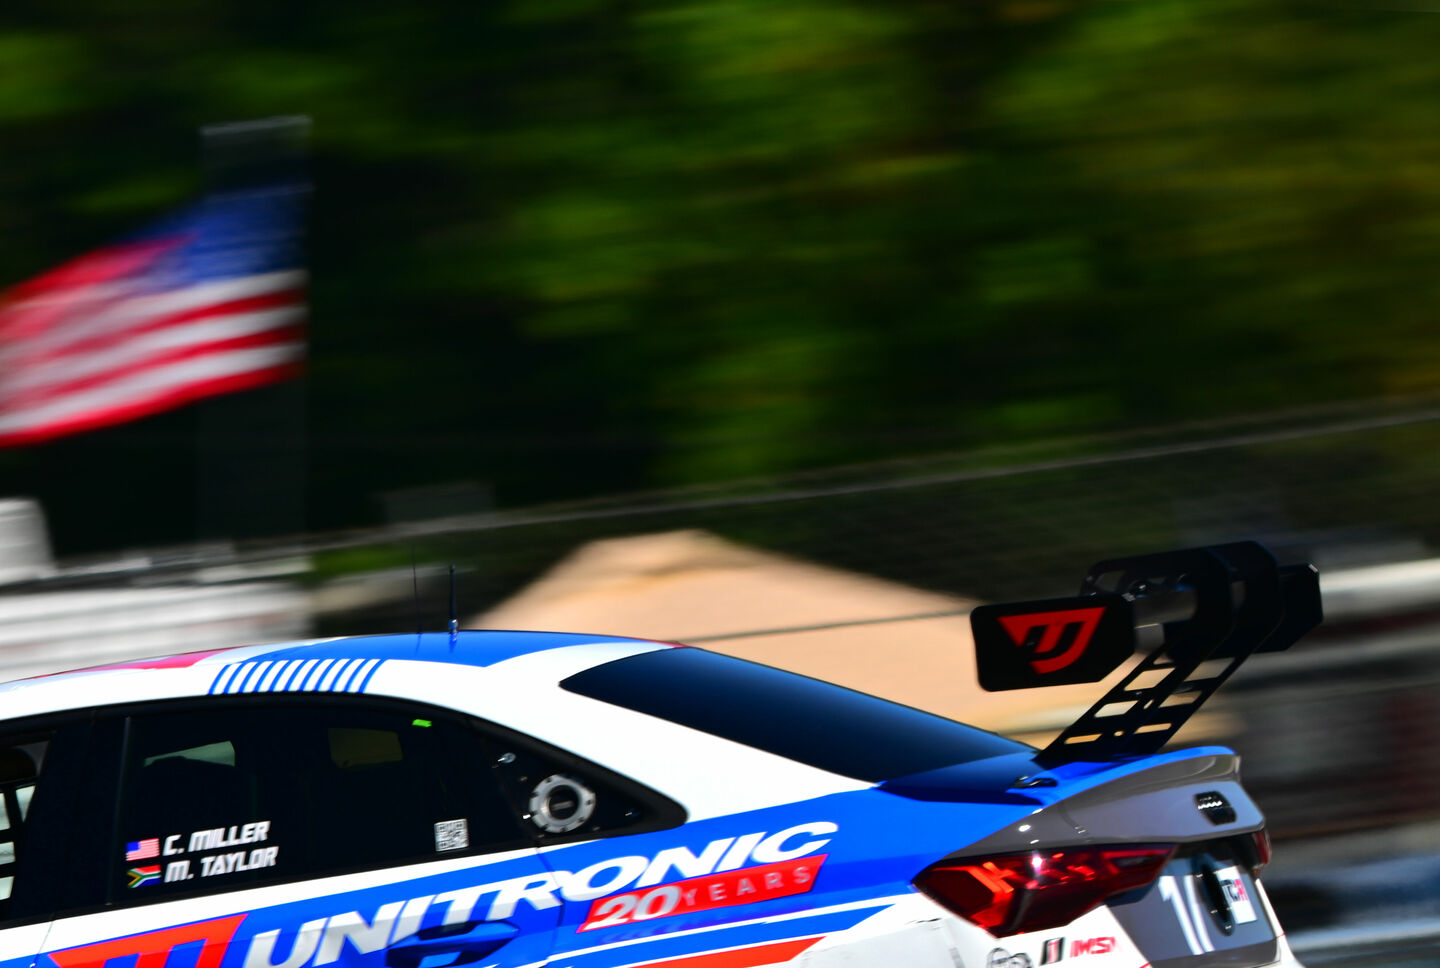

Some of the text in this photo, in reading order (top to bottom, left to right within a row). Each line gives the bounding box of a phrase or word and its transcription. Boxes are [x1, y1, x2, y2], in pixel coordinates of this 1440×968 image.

[163, 820, 271, 857] C. MILLER
[164, 846, 279, 883] M. TAYLOR
[581, 866, 812, 931] 20 YEARS
